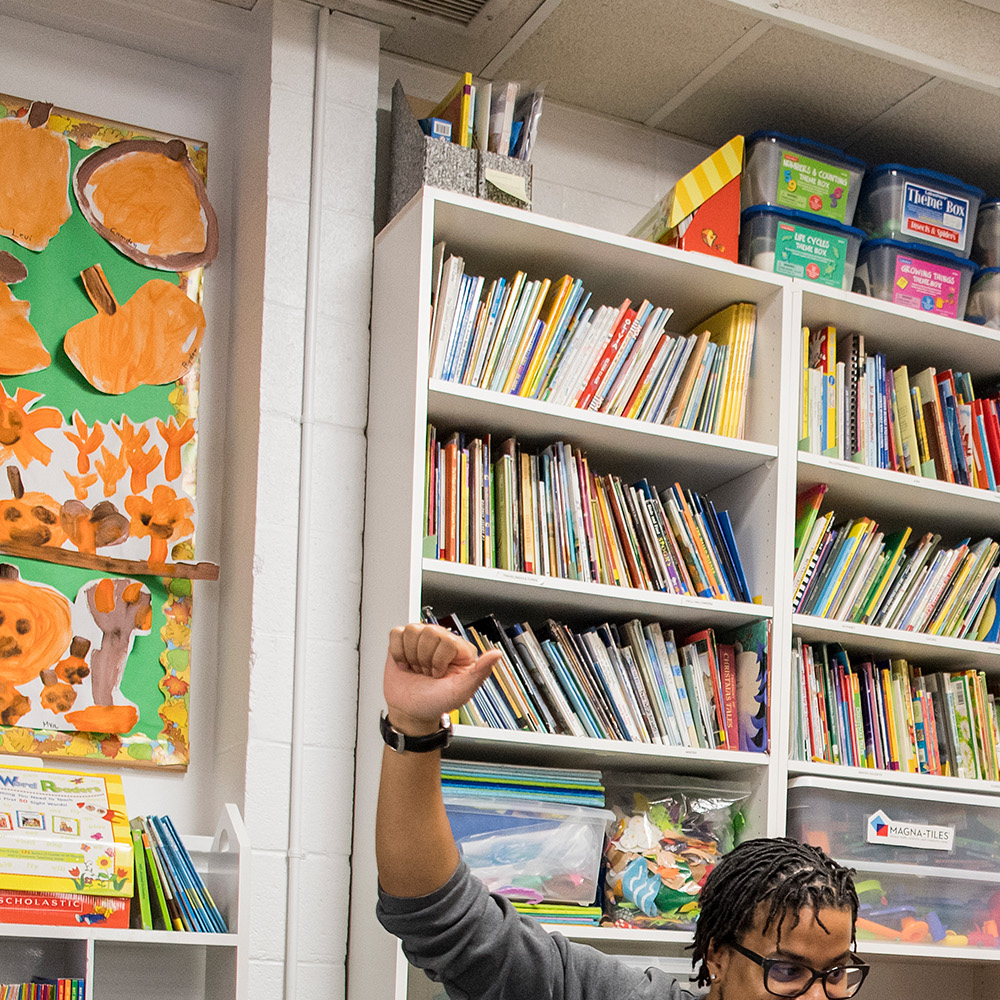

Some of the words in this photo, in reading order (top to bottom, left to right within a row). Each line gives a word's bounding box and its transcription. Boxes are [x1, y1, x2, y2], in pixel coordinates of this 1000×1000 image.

[817, 179, 830, 189] BOX
[818, 171, 847, 186] COUNTING
[908, 188, 942, 210] Theme
[946, 199, 965, 217] Box
[12, 229, 33, 241] Levi
[910, 221, 930, 235] Insects
[931, 227, 936, 235] &
[937, 228, 956, 241] Spiders
[794, 233, 806, 242] LIFE
[807, 236, 829, 248] CYCLES
[796, 242, 813, 253] THEME
[814, 248, 827, 256] BOX
[901, 265, 932, 278] GROWING
[933, 272, 954, 285] THINGS
[913, 276, 930, 285] THEME
[724, 653, 732, 702] CHRISTMAS
[725, 702, 733, 728] TALES
[40, 780, 101, 793] Readers
[889, 826, 949, 840] MAGNA-TILES
